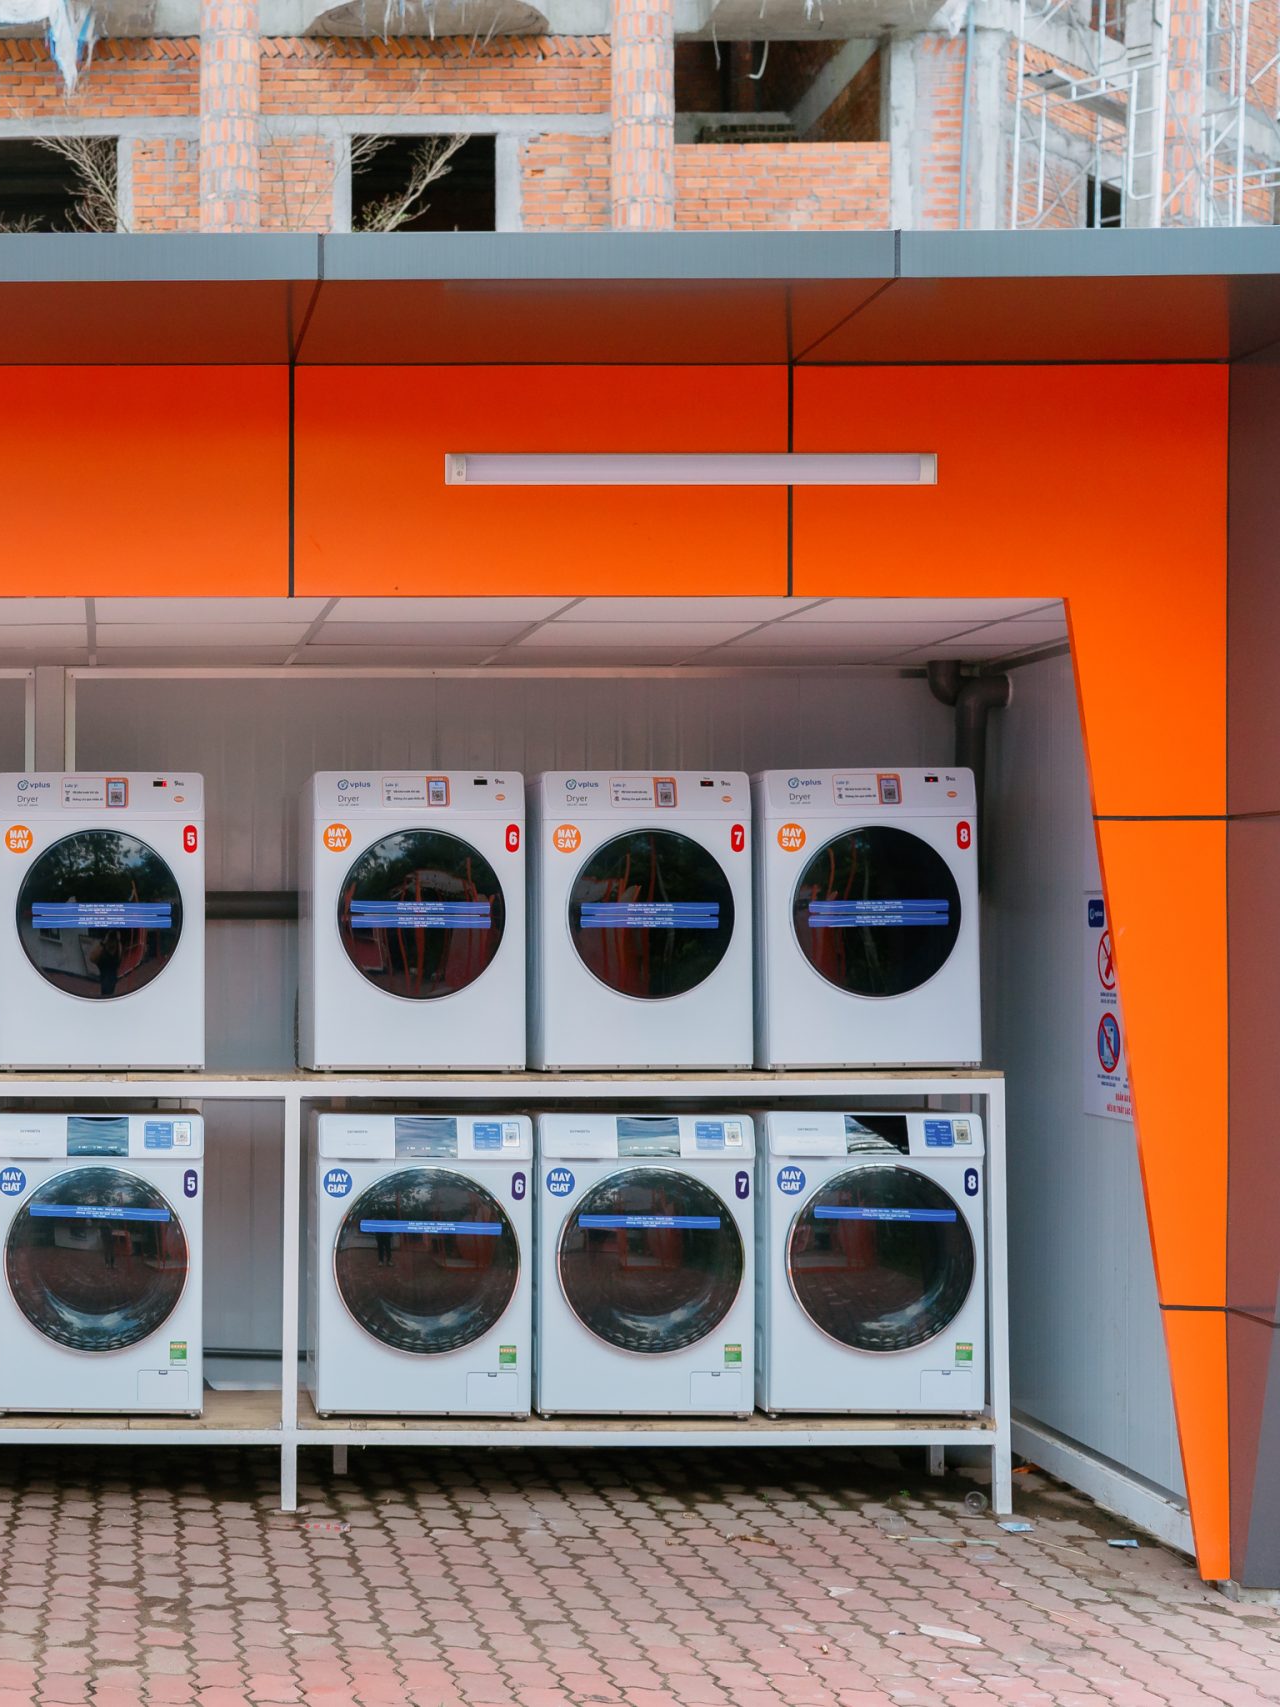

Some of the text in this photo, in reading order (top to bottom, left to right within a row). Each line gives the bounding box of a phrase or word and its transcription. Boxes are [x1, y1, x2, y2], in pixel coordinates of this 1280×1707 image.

[17, 796, 37, 804] Dryer
[338, 795, 359, 803] Dryer
[567, 795, 587, 803] Dryer
[790, 793, 810, 801] Dryer
[187, 832, 195, 846] 5
[509, 832, 517, 845] 6
[735, 832, 742, 845] 7
[961, 829, 968, 842] 8
[188, 1177, 195, 1191] 5
[515, 1179, 523, 1193] 6
[739, 1178, 747, 1192] 7
[968, 1175, 976, 1189] 8
